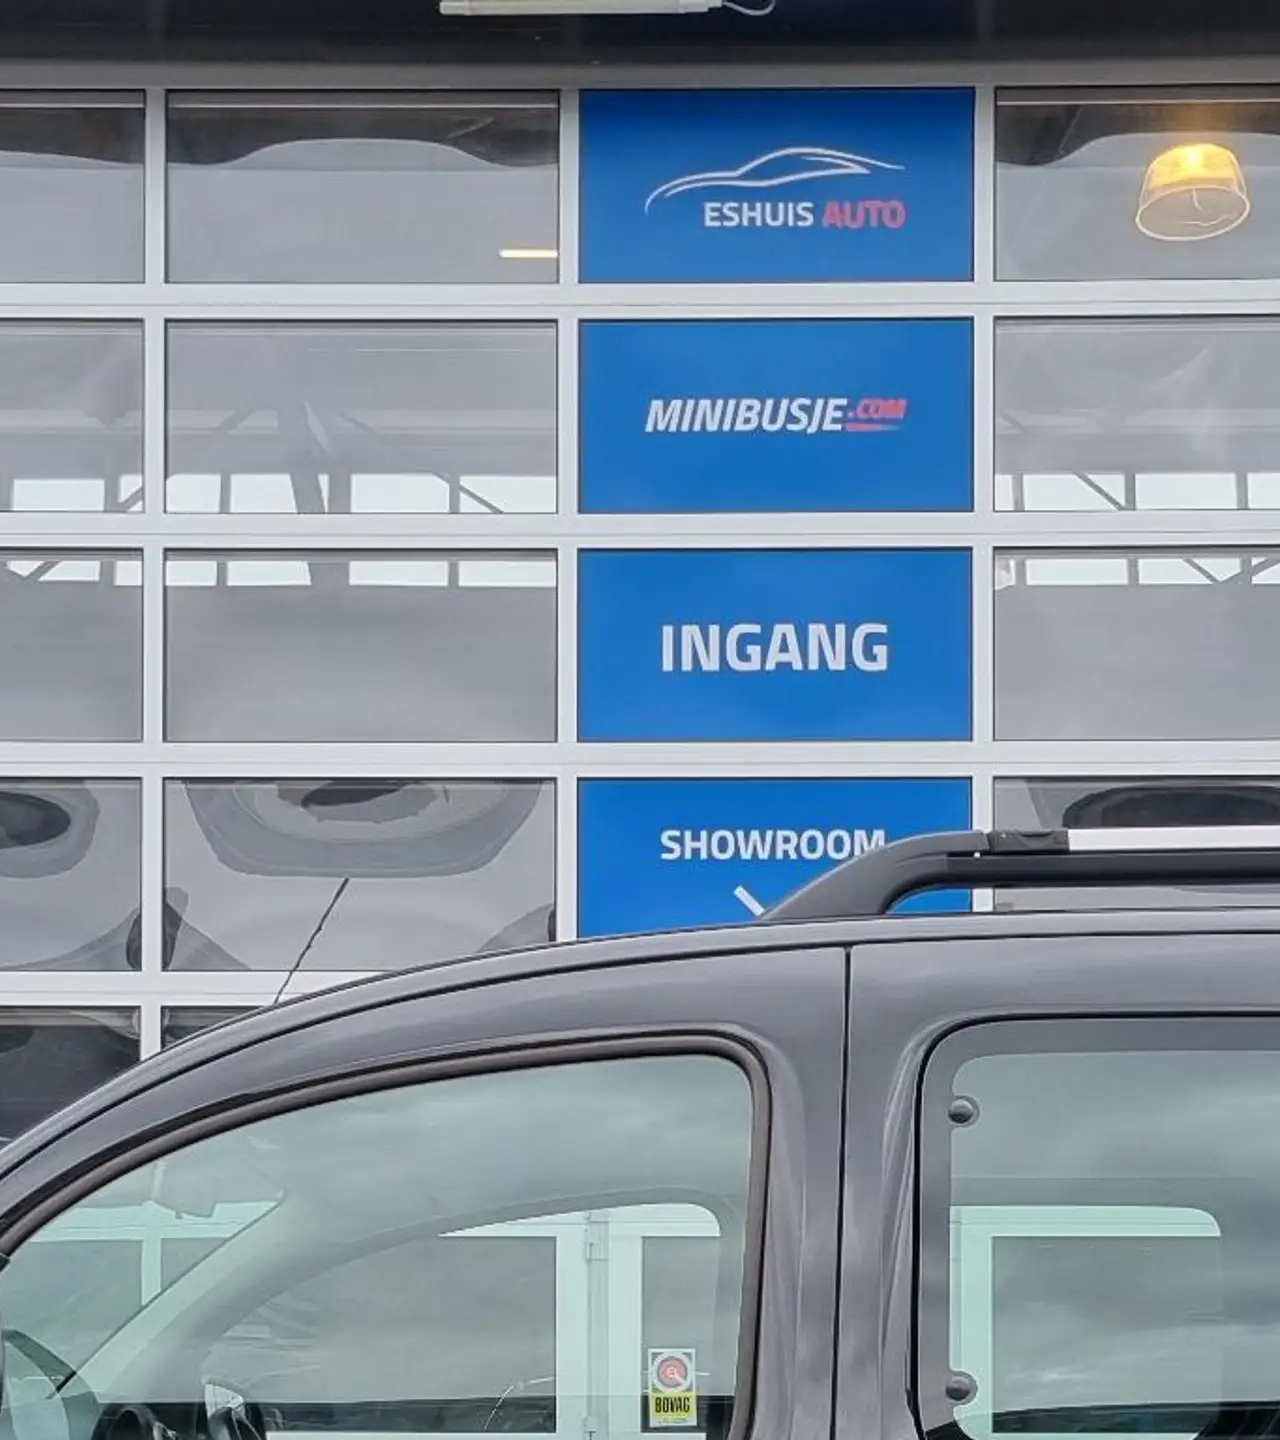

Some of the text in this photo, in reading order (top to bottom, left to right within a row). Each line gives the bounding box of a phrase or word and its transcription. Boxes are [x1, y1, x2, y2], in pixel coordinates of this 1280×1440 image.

[704, 200, 906, 229] ESHUIS AUTO
[662, 623, 888, 672] INGANG
[660, 829, 885, 860] SHOWROOM
